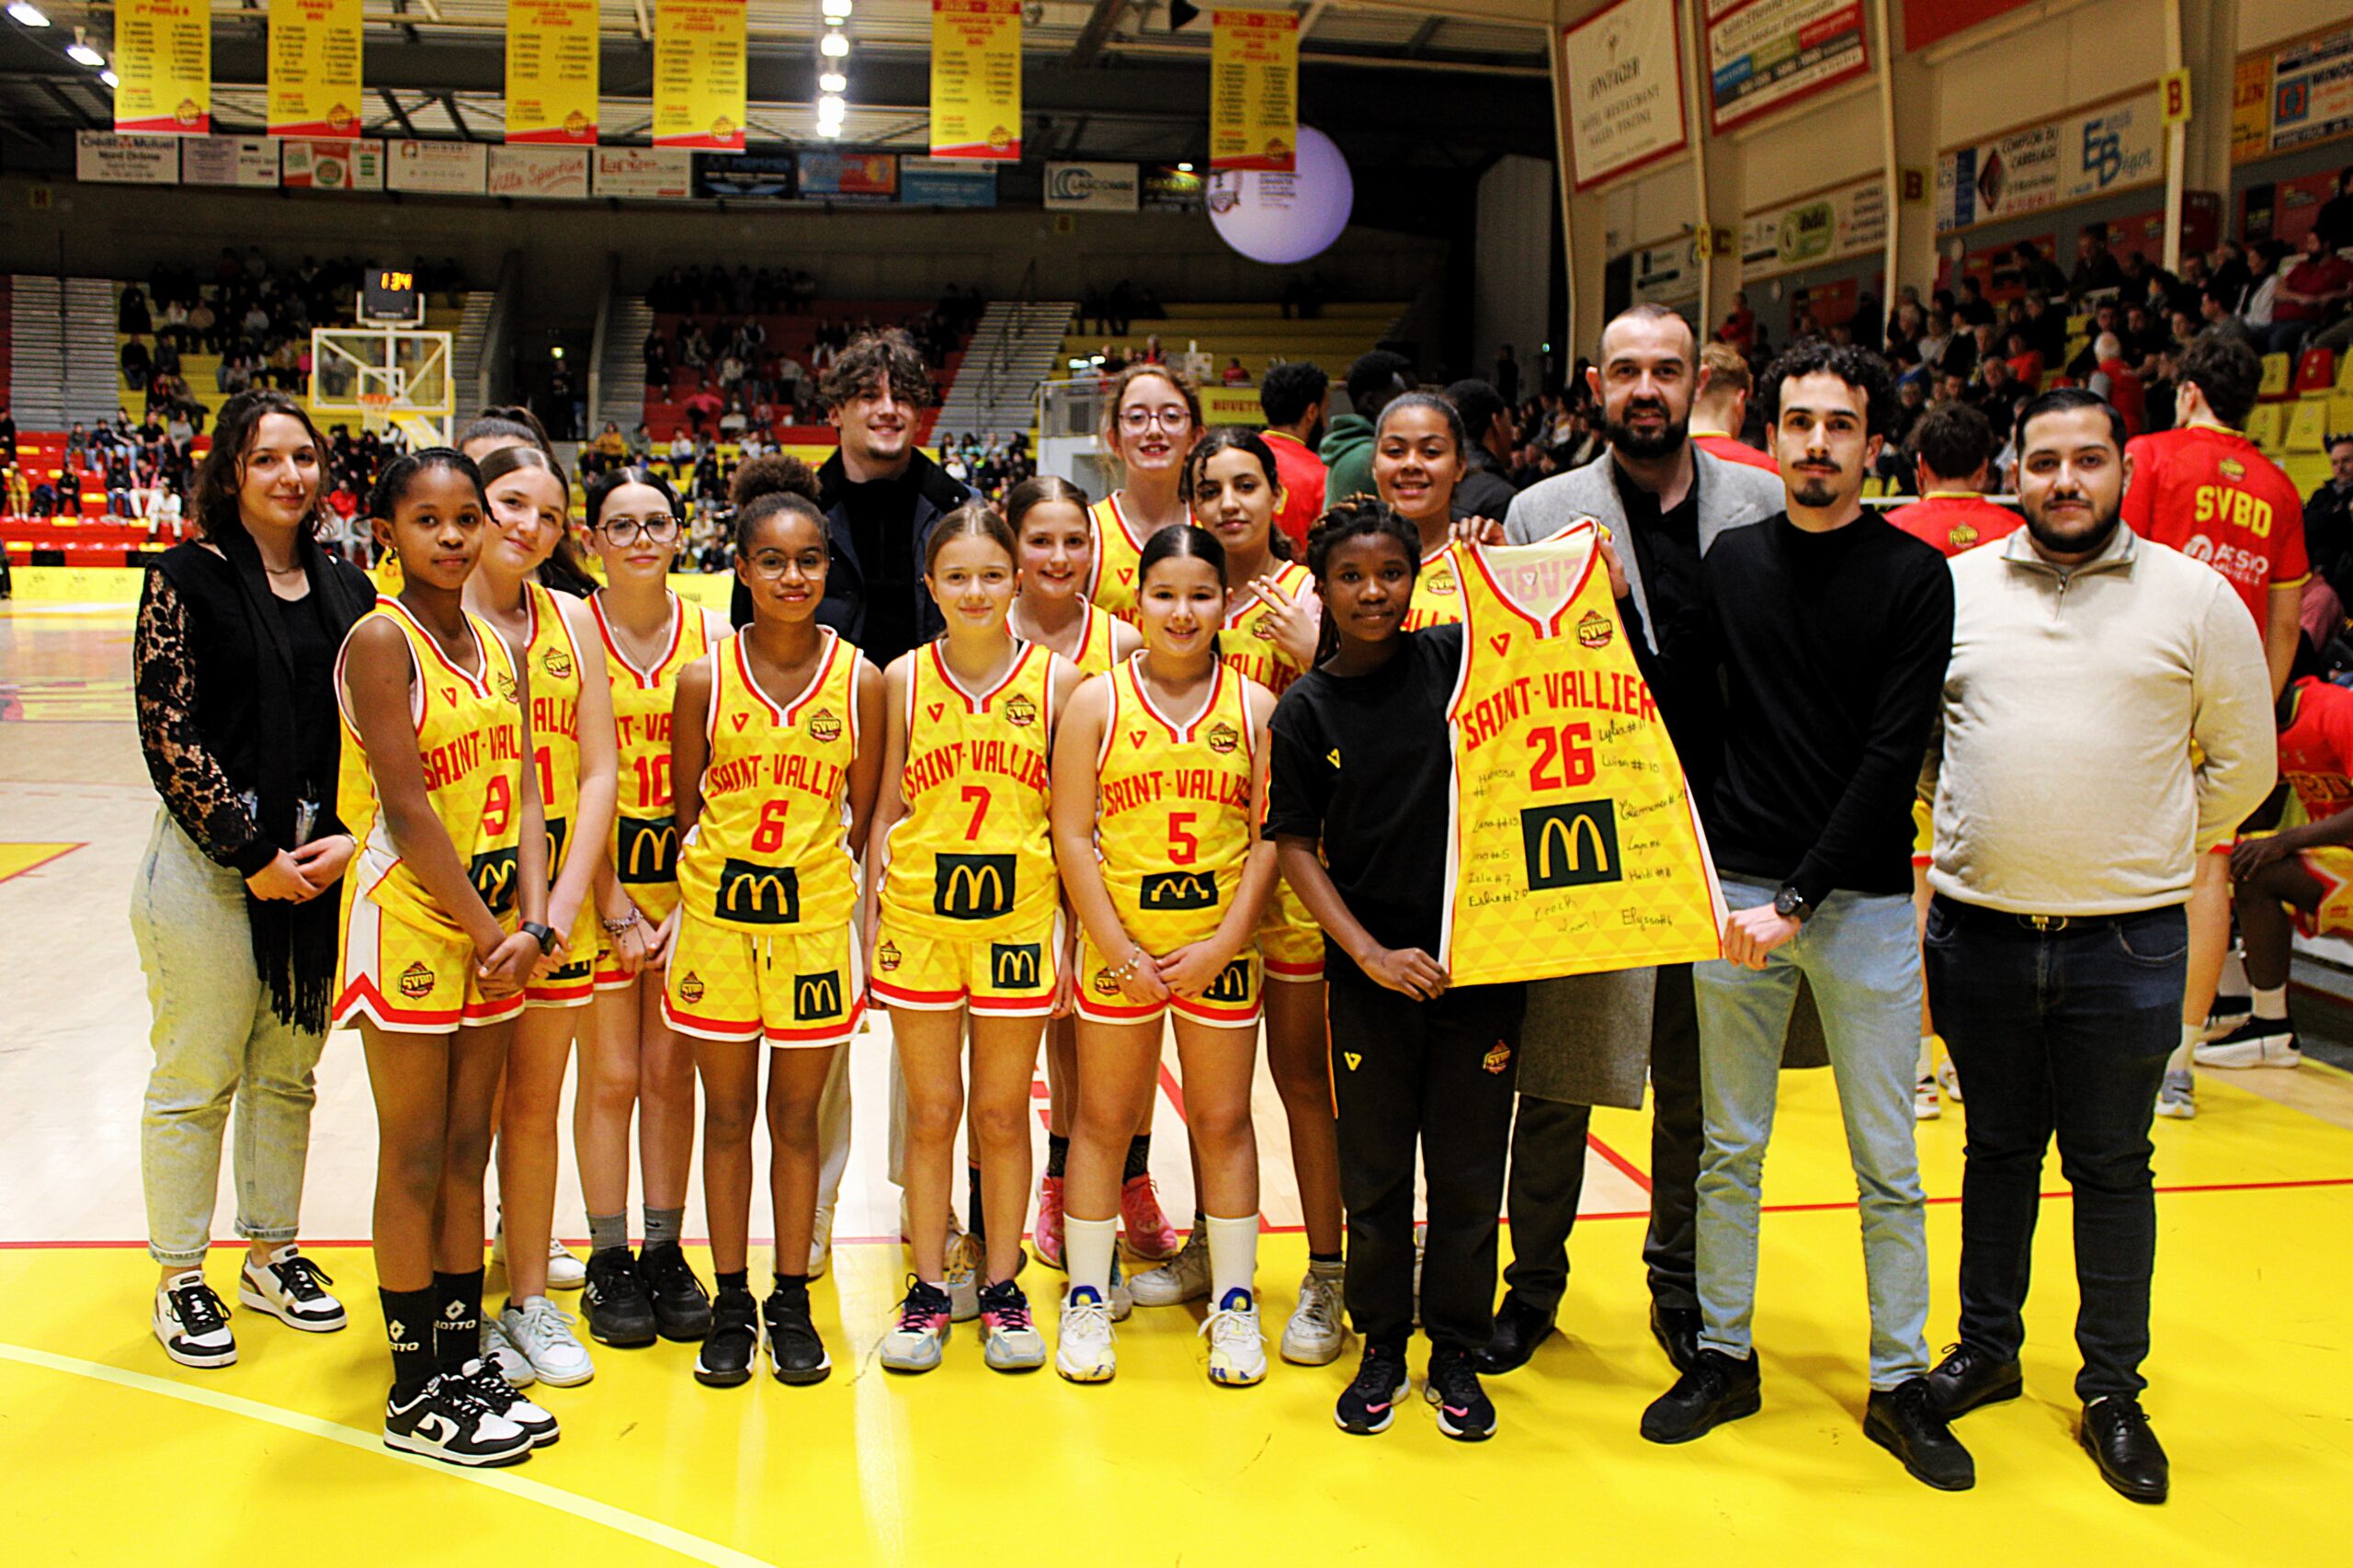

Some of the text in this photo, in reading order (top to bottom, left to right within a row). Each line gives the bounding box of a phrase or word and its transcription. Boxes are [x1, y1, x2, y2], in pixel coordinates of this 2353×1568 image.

[2166, 80, 2183, 116] B
[1905, 170, 1924, 200] B
[2195, 485, 2273, 539] SVBD
[1461, 670, 1658, 753] SAINT-VALLIER
[634, 754, 674, 809] 10
[1526, 722, 1597, 792] 26
[481, 774, 512, 840] 9
[750, 799, 790, 854] 6
[961, 785, 992, 841] 7
[1167, 812, 1199, 866] 5
[403, 973, 434, 990] SVBD
